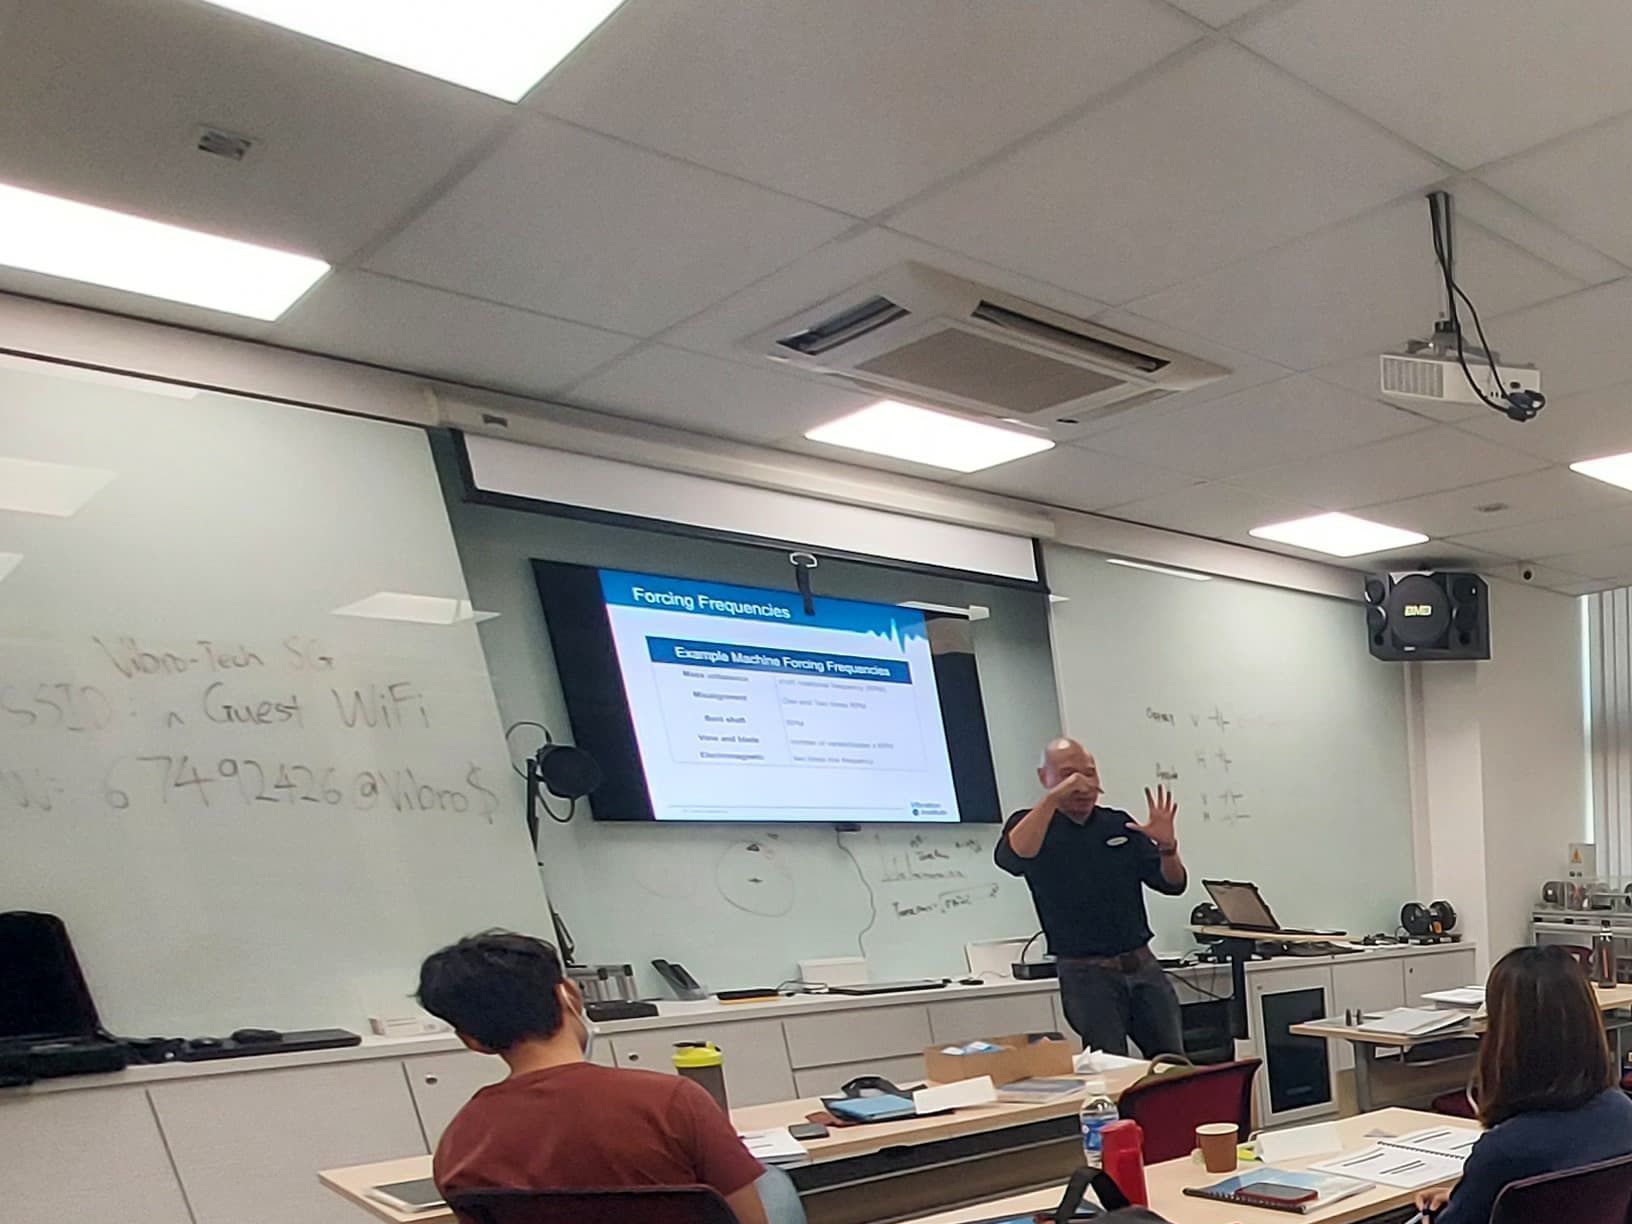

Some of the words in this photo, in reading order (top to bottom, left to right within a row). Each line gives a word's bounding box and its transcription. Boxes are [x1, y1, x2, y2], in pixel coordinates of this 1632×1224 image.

[632, 586, 694, 611] Forcing
[698, 595, 791, 619] Frequencies
[673, 646, 729, 664] Example
[731, 651, 781, 668] Machine
[783, 656, 825, 673] Forcing
[826, 661, 891, 678] Frequencies
[203, 681, 305, 729] Guest
[331, 681, 429, 729] WiFi
